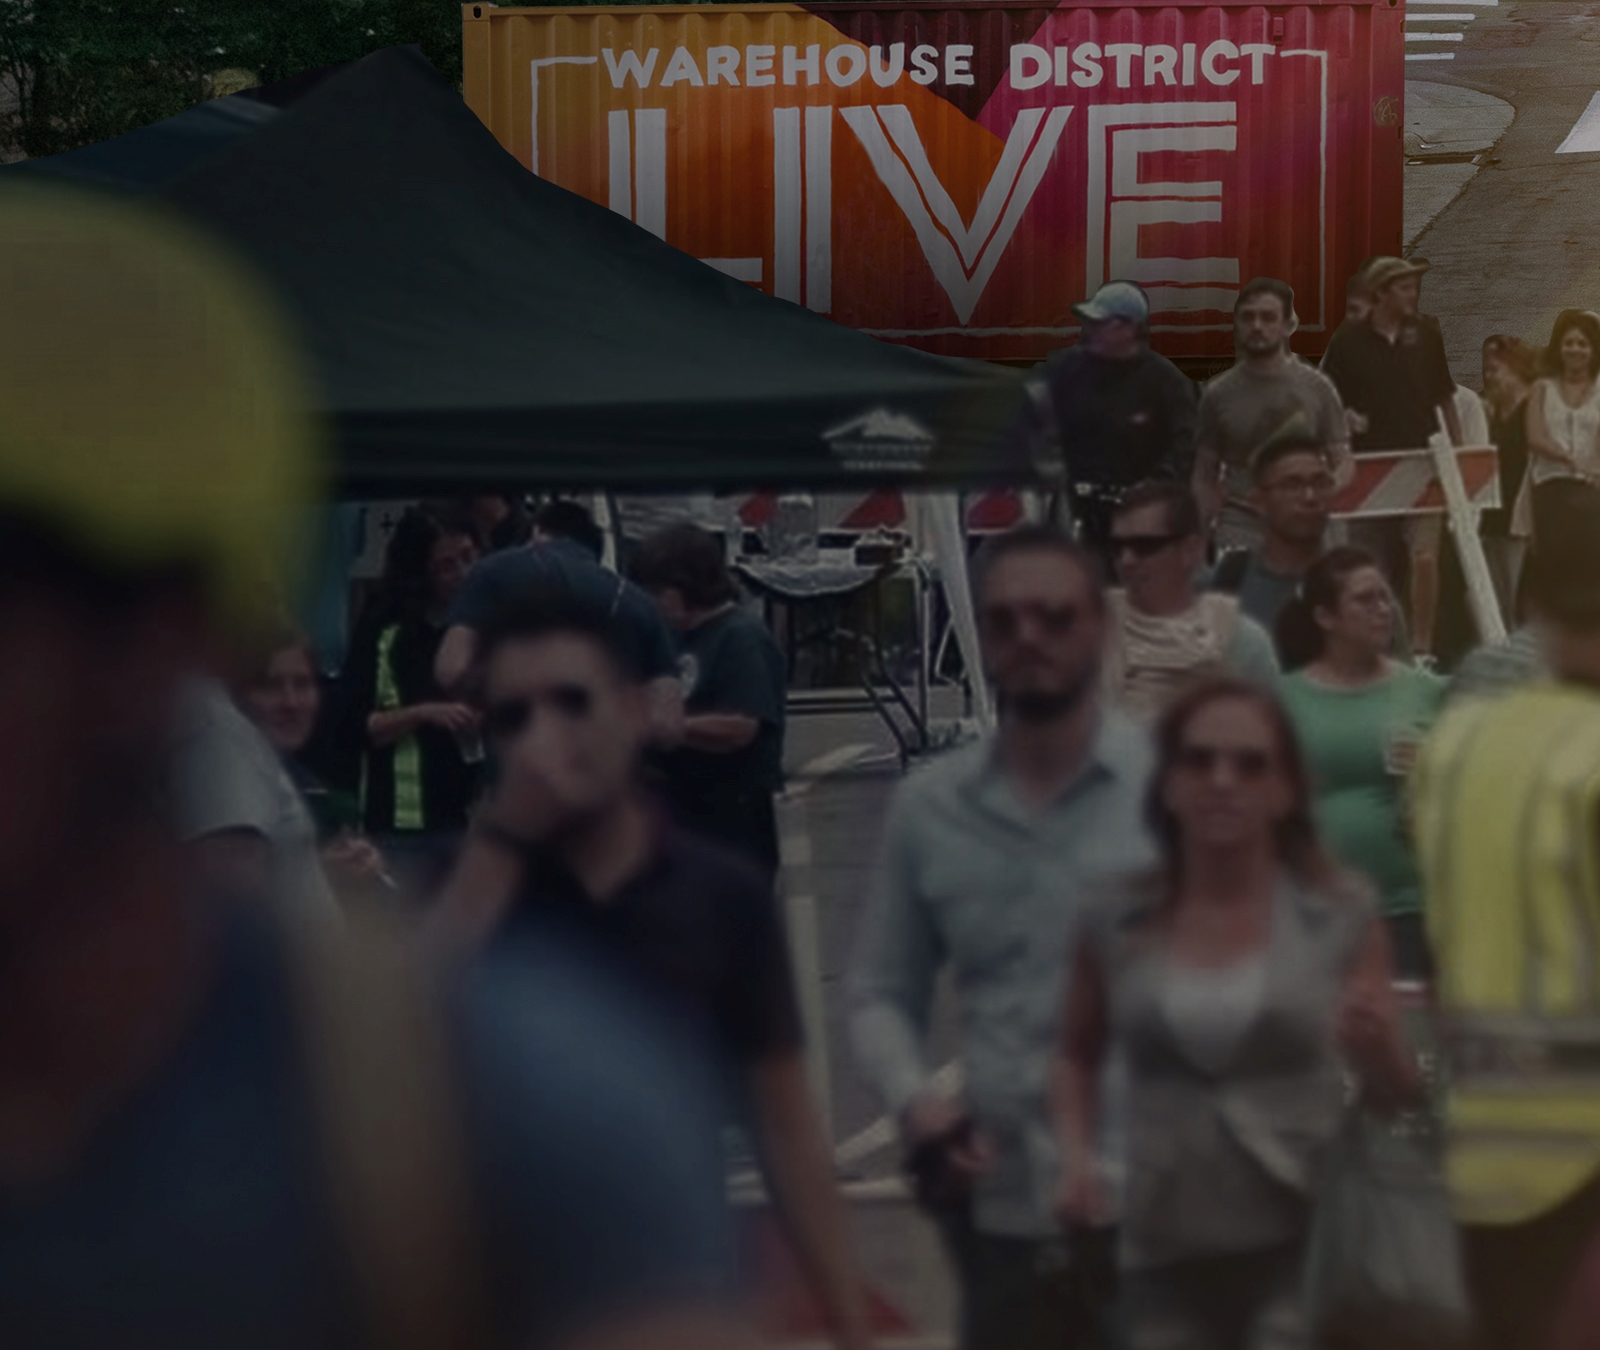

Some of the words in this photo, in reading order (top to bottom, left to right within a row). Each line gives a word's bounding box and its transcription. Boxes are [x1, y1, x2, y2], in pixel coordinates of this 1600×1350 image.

[601, 43, 974, 89] WAREHOUSE
[1009, 38, 1276, 89] DISTRICT
[608, 102, 1240, 326] LIVE
